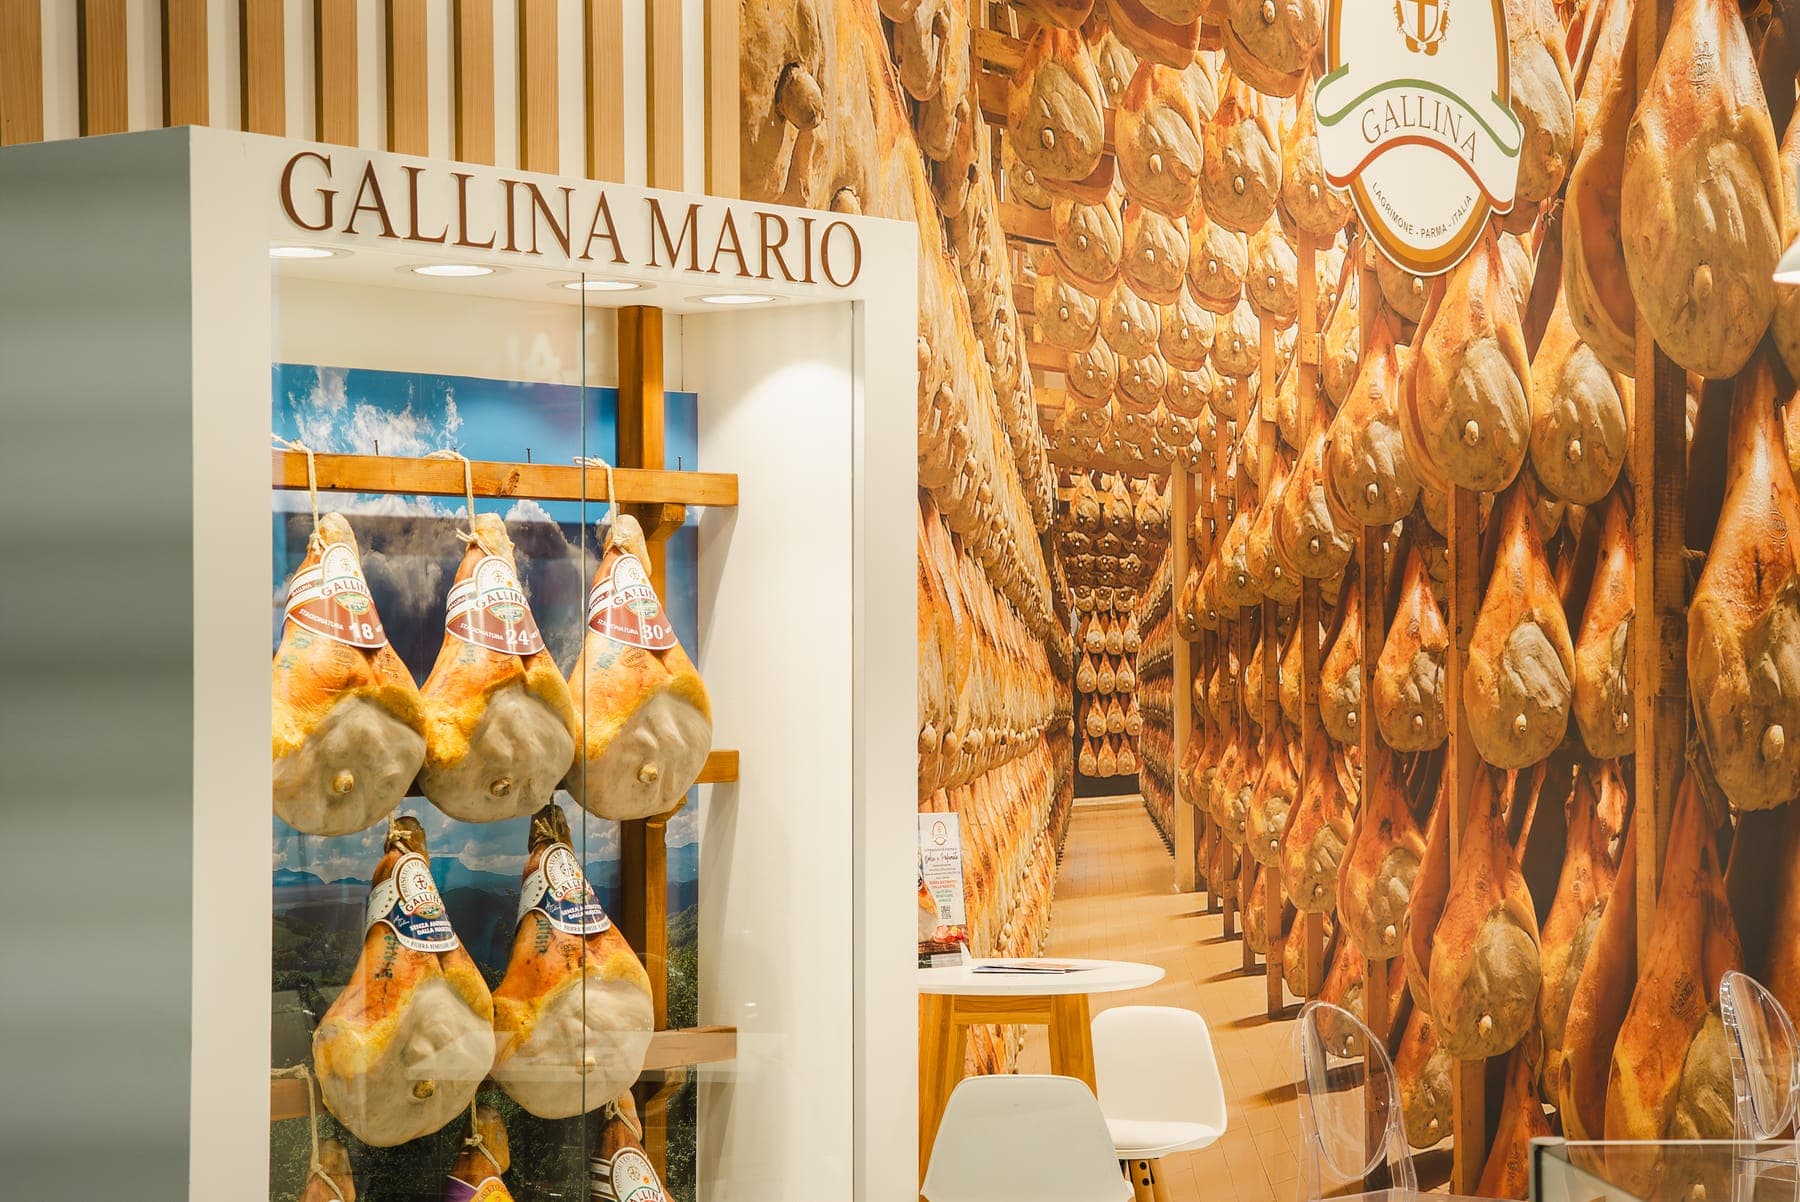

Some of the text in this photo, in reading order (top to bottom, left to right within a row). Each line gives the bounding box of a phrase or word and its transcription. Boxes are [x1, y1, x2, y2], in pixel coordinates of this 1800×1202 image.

[1361, 95, 1477, 163] GALLINA
[280, 151, 863, 288] GALLINA MARIO
[1372, 182, 1414, 235] LAGRIMONE
[1421, 224, 1447, 238] PARMA
[1452, 195, 1472, 225] ITALIA
[349, 622, 374, 640] 18
[505, 629, 530, 645] 24
[643, 624, 664, 640] 30
